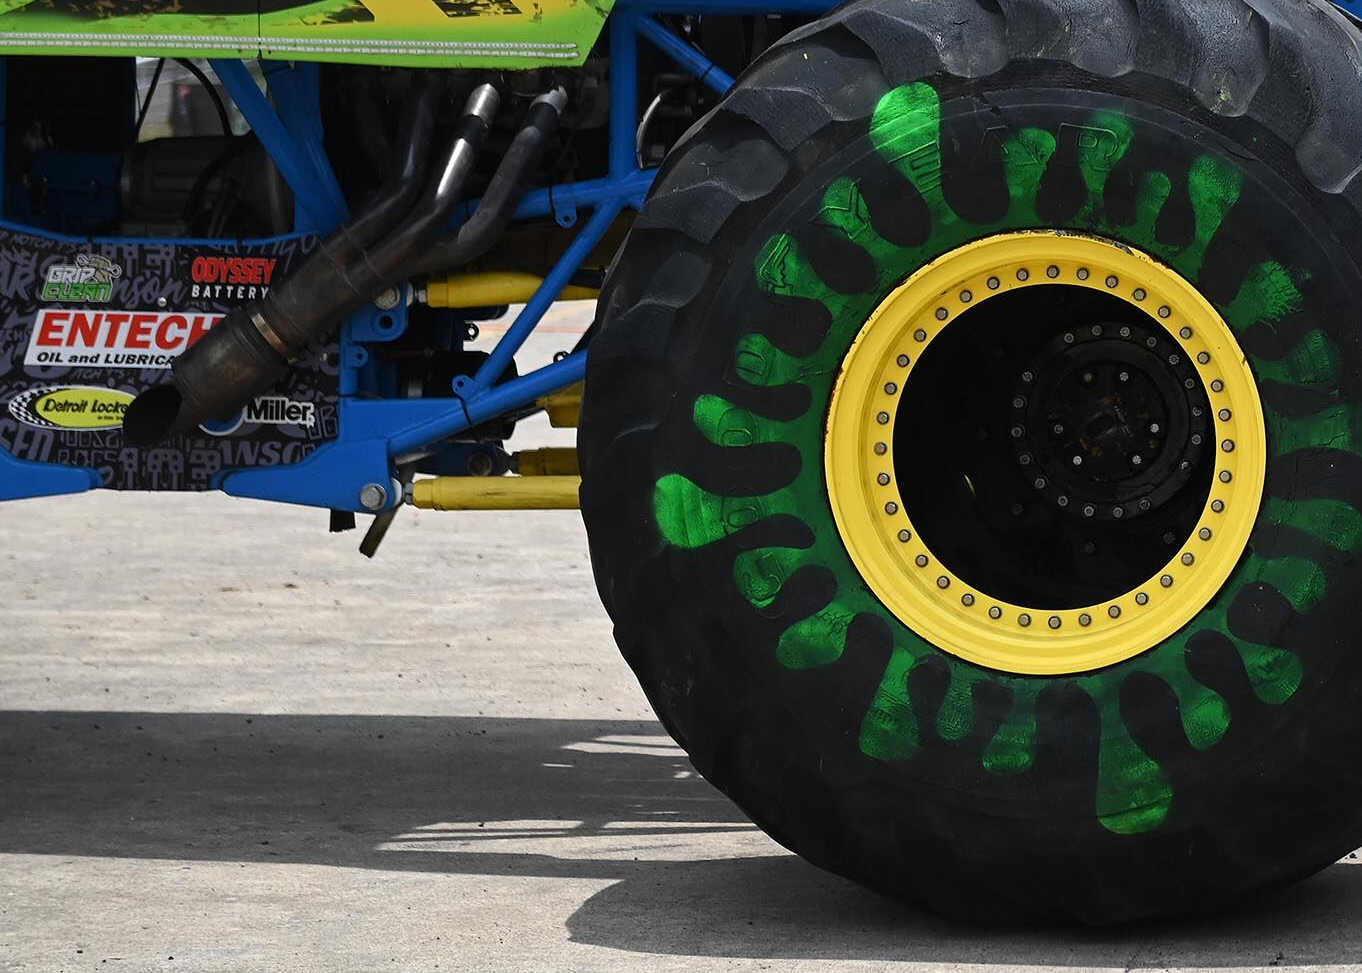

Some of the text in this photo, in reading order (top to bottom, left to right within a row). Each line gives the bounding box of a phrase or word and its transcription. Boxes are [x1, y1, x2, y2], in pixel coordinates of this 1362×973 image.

[49, 267, 96, 284] GRIP
[192, 256, 276, 284] ODYSSEY
[192, 284, 269, 299] BATTERY
[37, 352, 63, 363] OIL
[68, 353, 100, 364] and
[43, 398, 88, 413] Detroit
[247, 399, 311, 421] Miller
